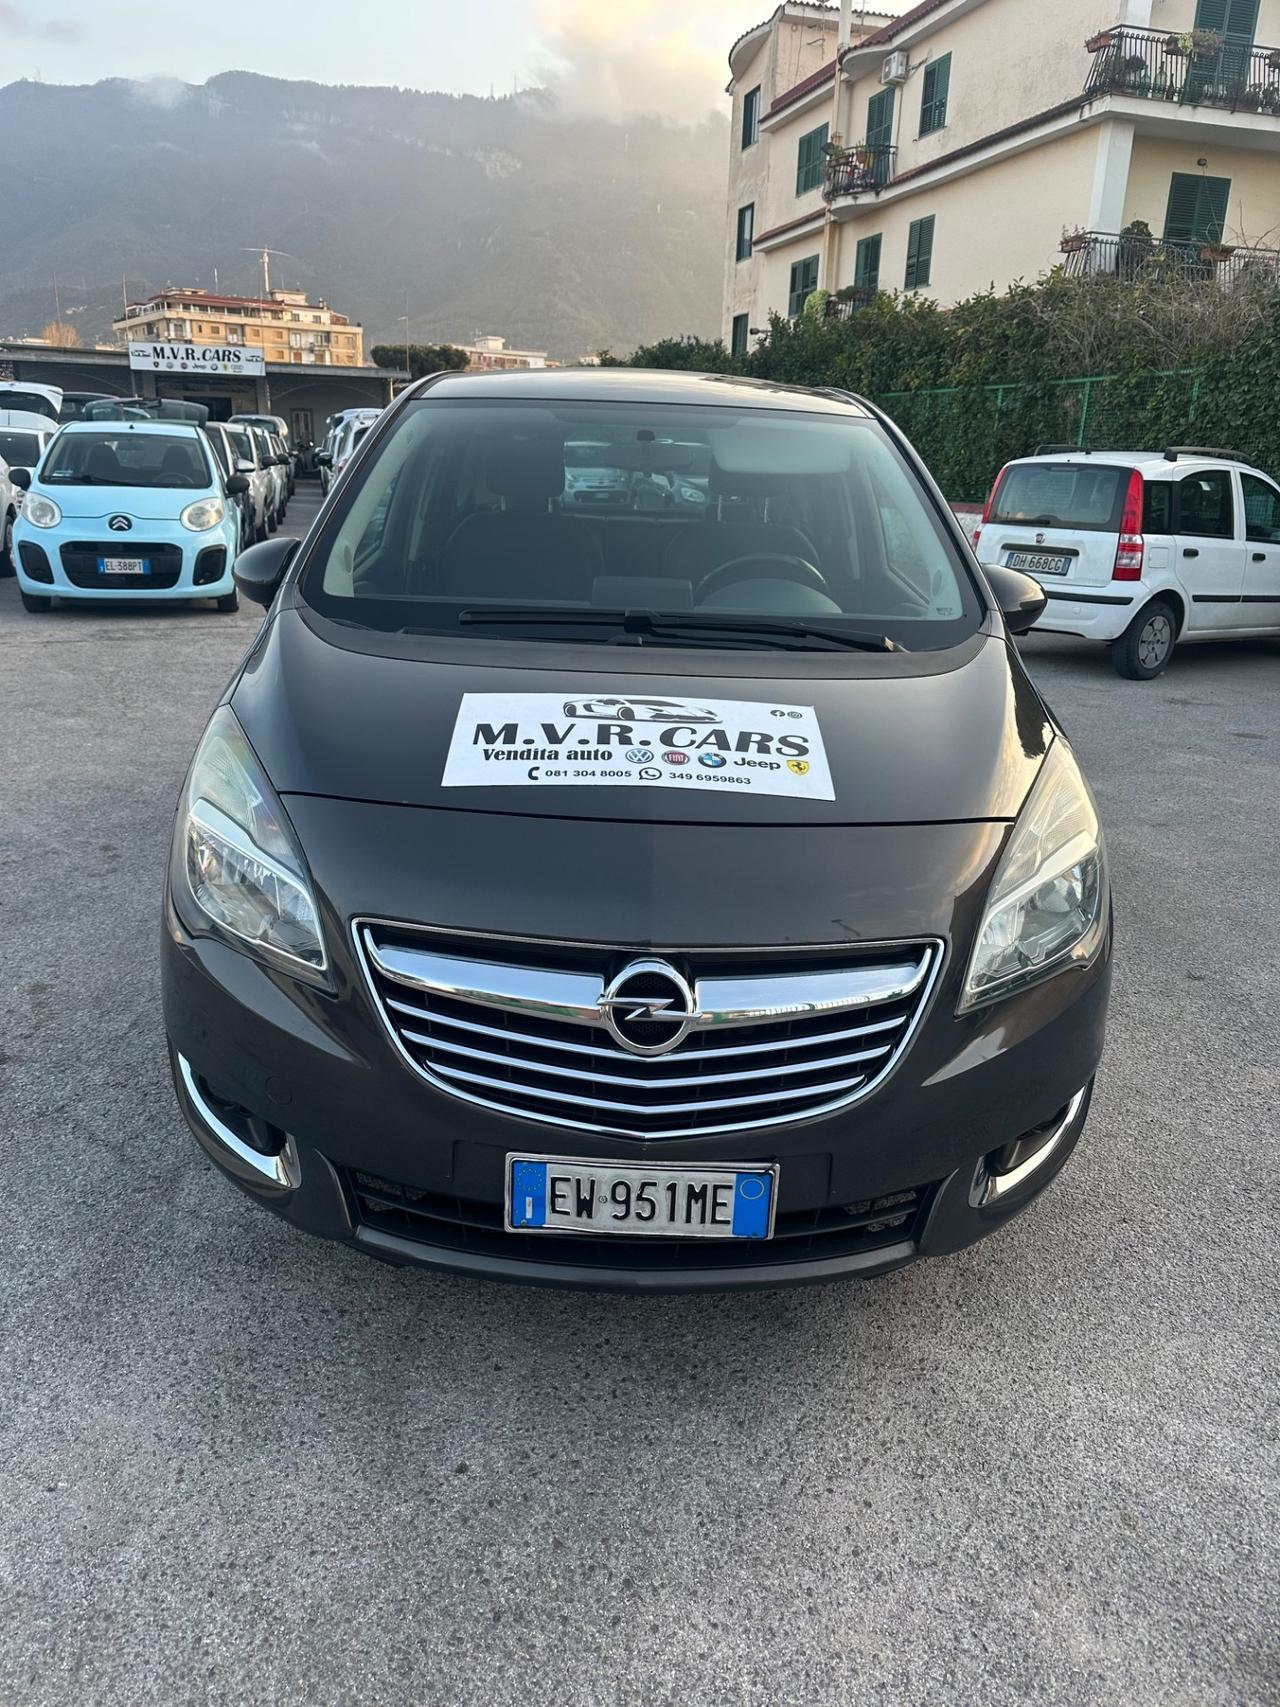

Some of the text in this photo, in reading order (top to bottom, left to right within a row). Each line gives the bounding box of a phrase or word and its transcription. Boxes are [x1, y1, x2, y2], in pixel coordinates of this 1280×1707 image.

[483, 748, 613, 761] Vendita auto
[733, 757, 781, 770] Jeep
[545, 769, 632, 777] 081 304 8005
[669, 772, 751, 785] 349 6959863
[550, 1176, 733, 1225] EW 951ME
